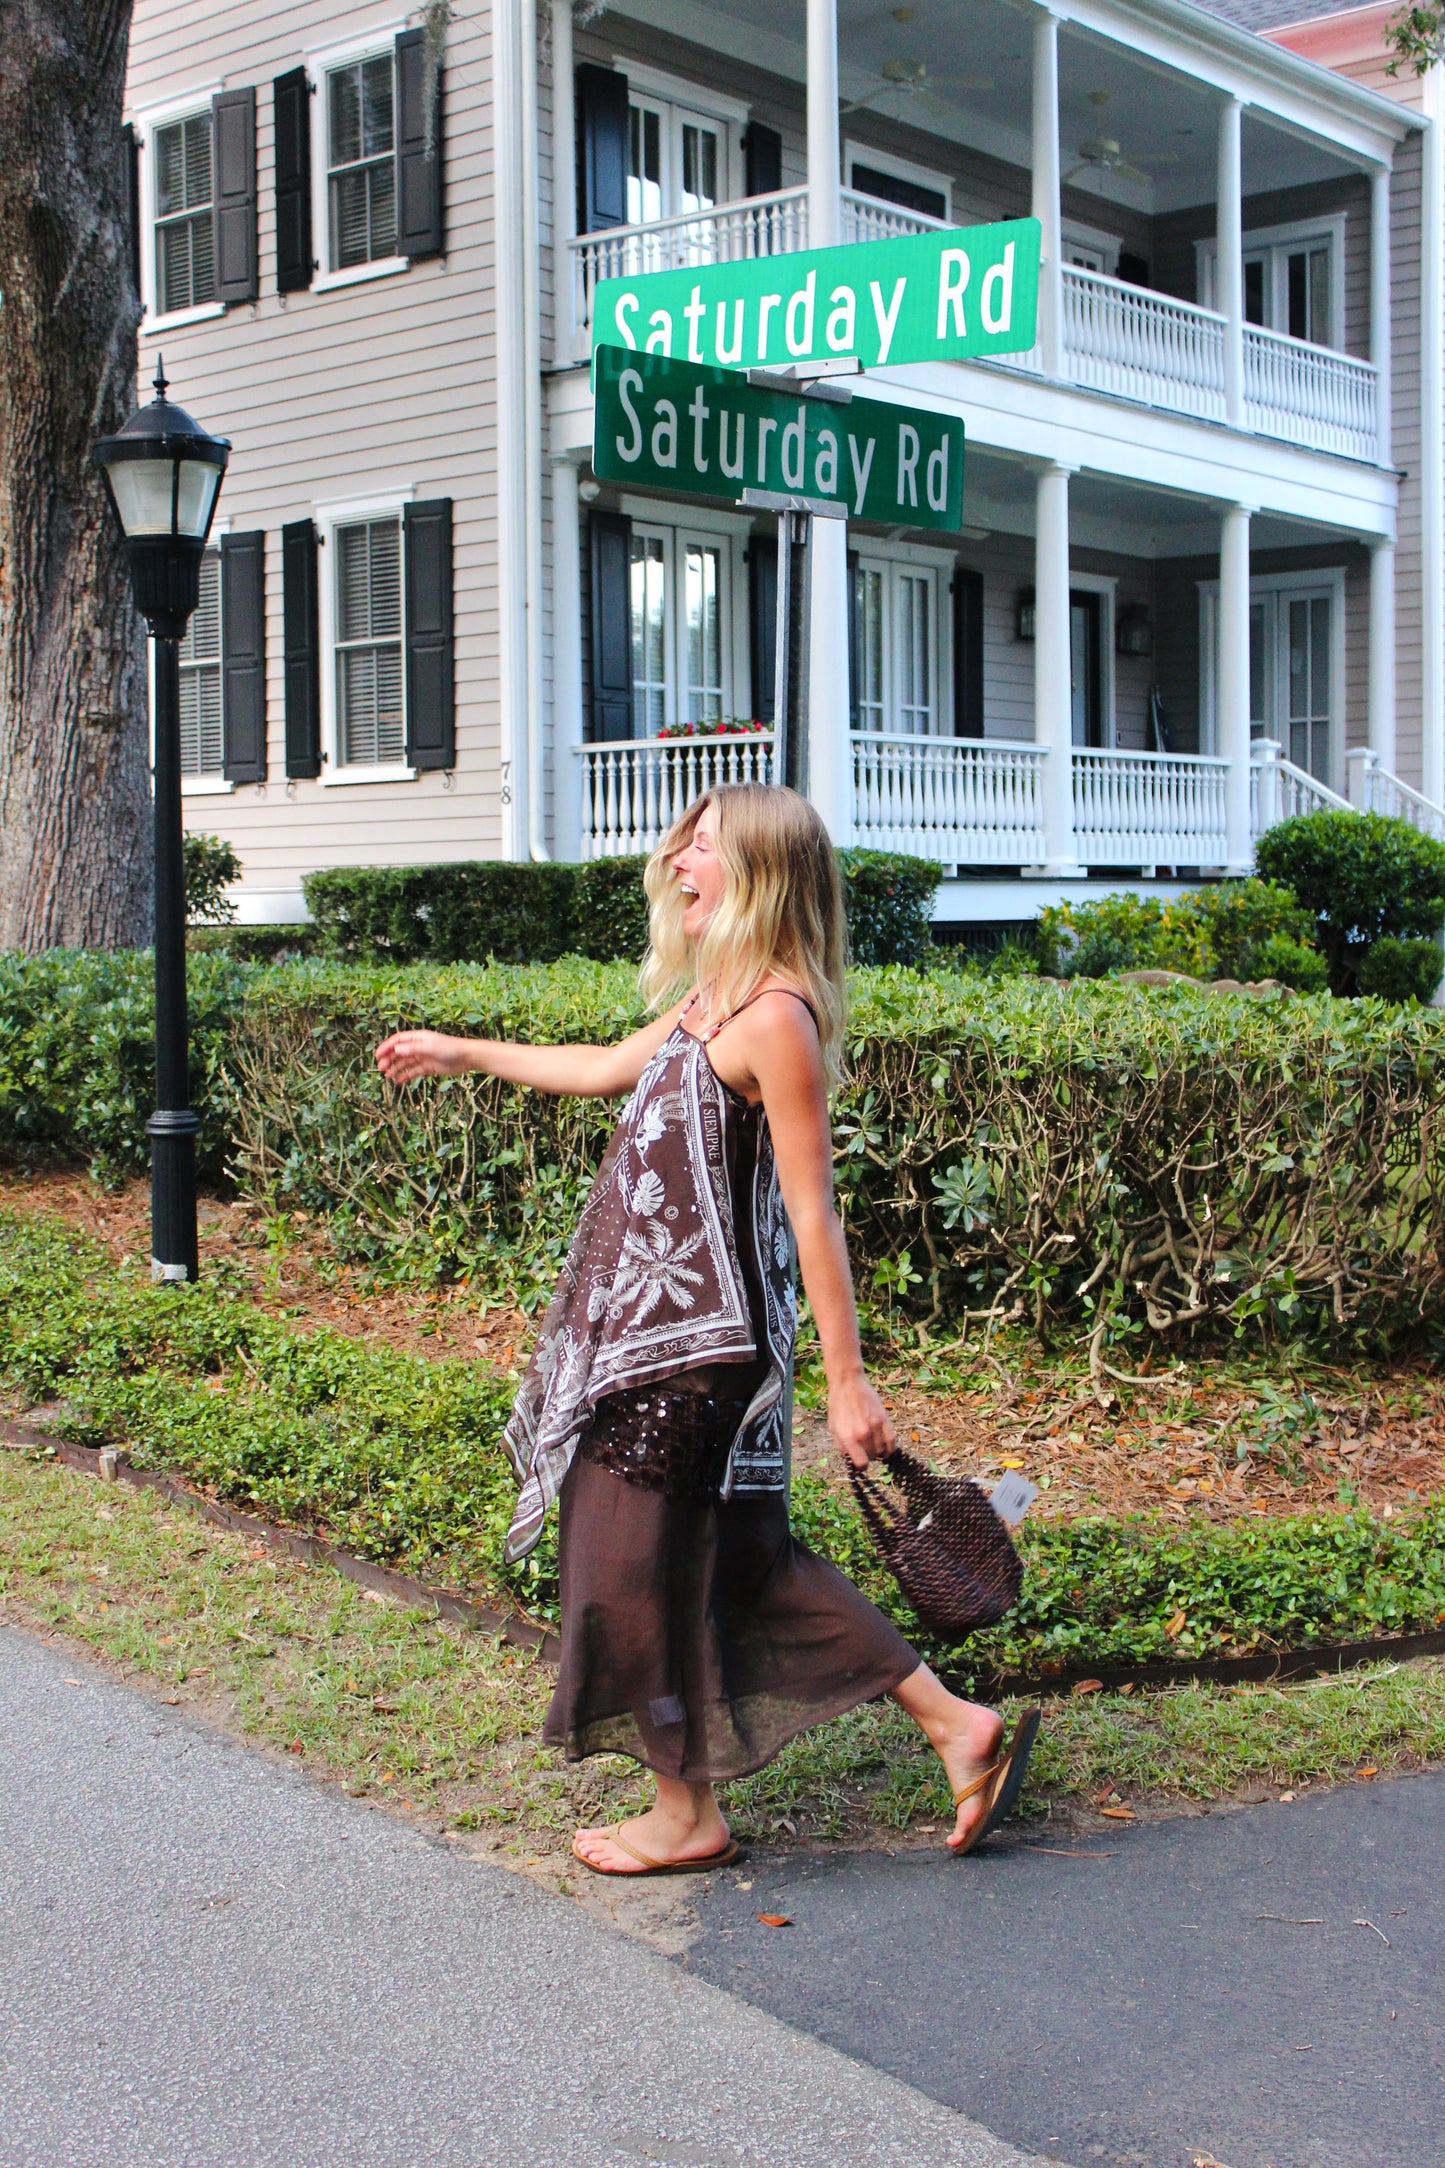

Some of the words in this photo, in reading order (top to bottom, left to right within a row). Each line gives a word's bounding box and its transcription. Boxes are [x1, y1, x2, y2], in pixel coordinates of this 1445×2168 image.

[614, 269, 907, 364] Saturday
[936, 241, 1016, 340] Rd
[616, 368, 875, 515] Saturday
[897, 424, 950, 512] Rd
[703, 1108, 721, 1161] SIEMPRE
[766, 1281, 778, 1329] SIEMPR
